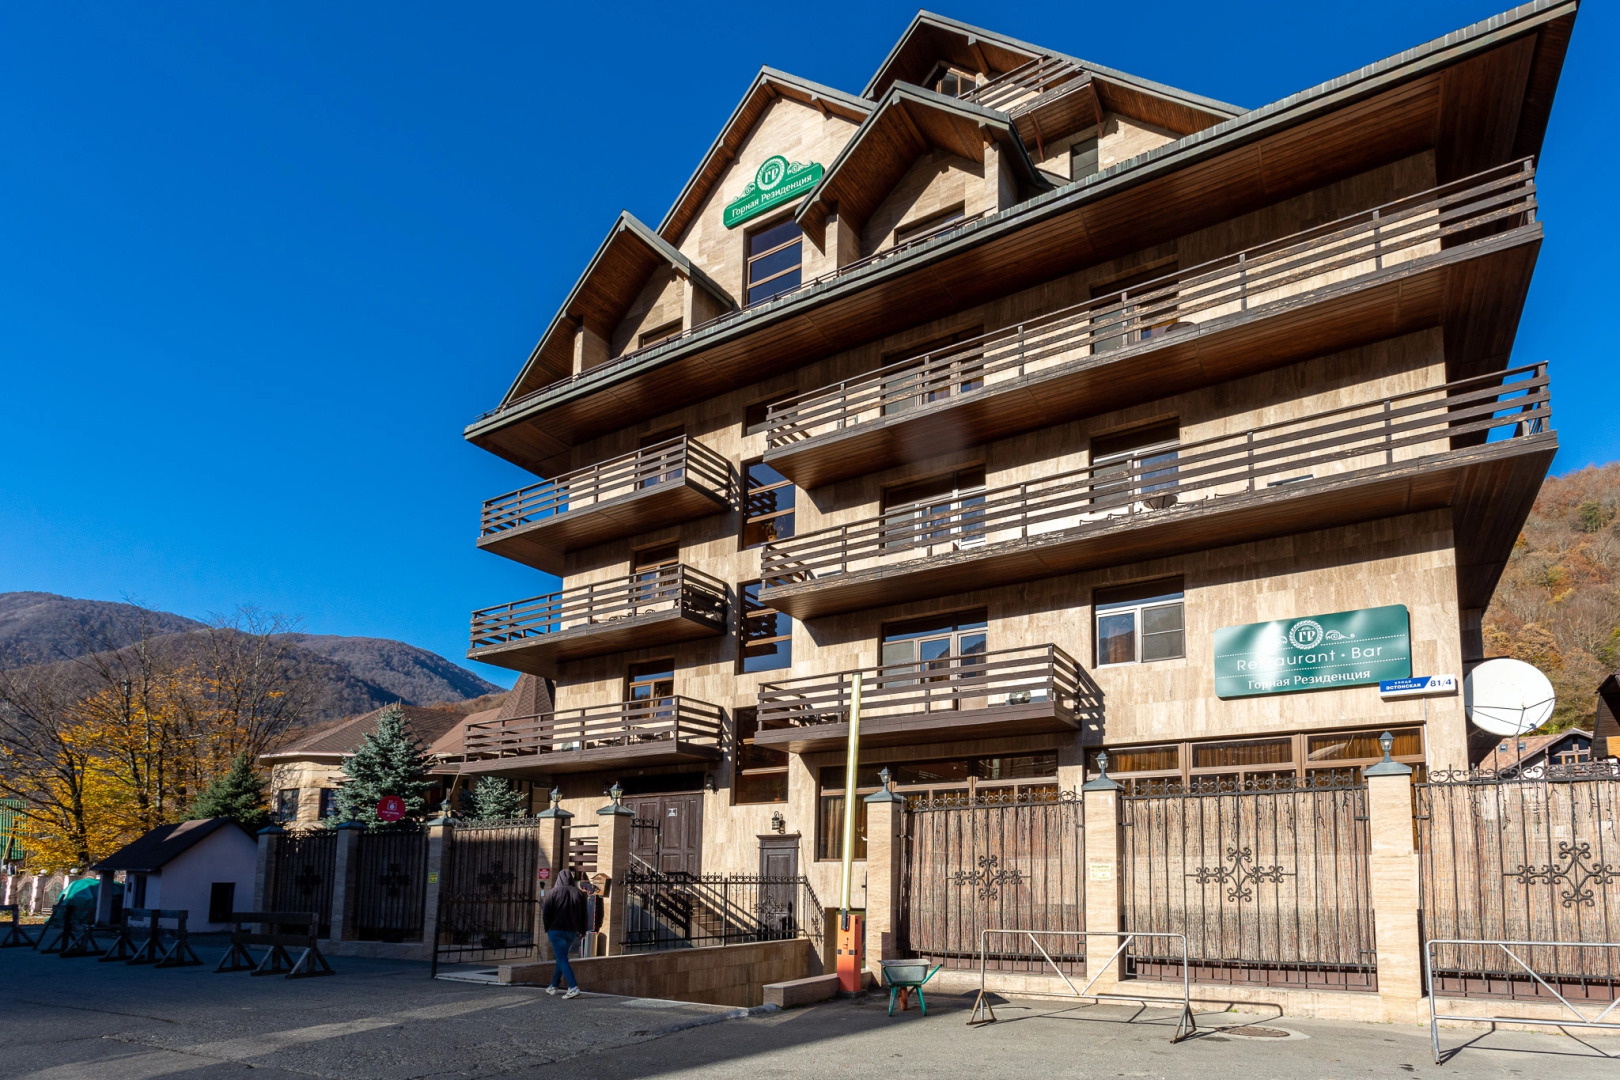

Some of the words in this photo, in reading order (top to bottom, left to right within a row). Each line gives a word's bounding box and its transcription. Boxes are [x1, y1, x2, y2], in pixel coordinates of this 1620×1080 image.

[732, 199, 759, 217] Горная
[761, 175, 812, 202] Резиденция
[1237, 650, 1336, 671] Reaurant
[1351, 646, 1382, 659] Bar
[1248, 678, 1290, 690] Горная
[1294, 670, 1371, 685] Резиденция
[1385, 682, 1421, 690] ЭСТОНСКАЯ
[1430, 679, 1452, 687] 81/4
